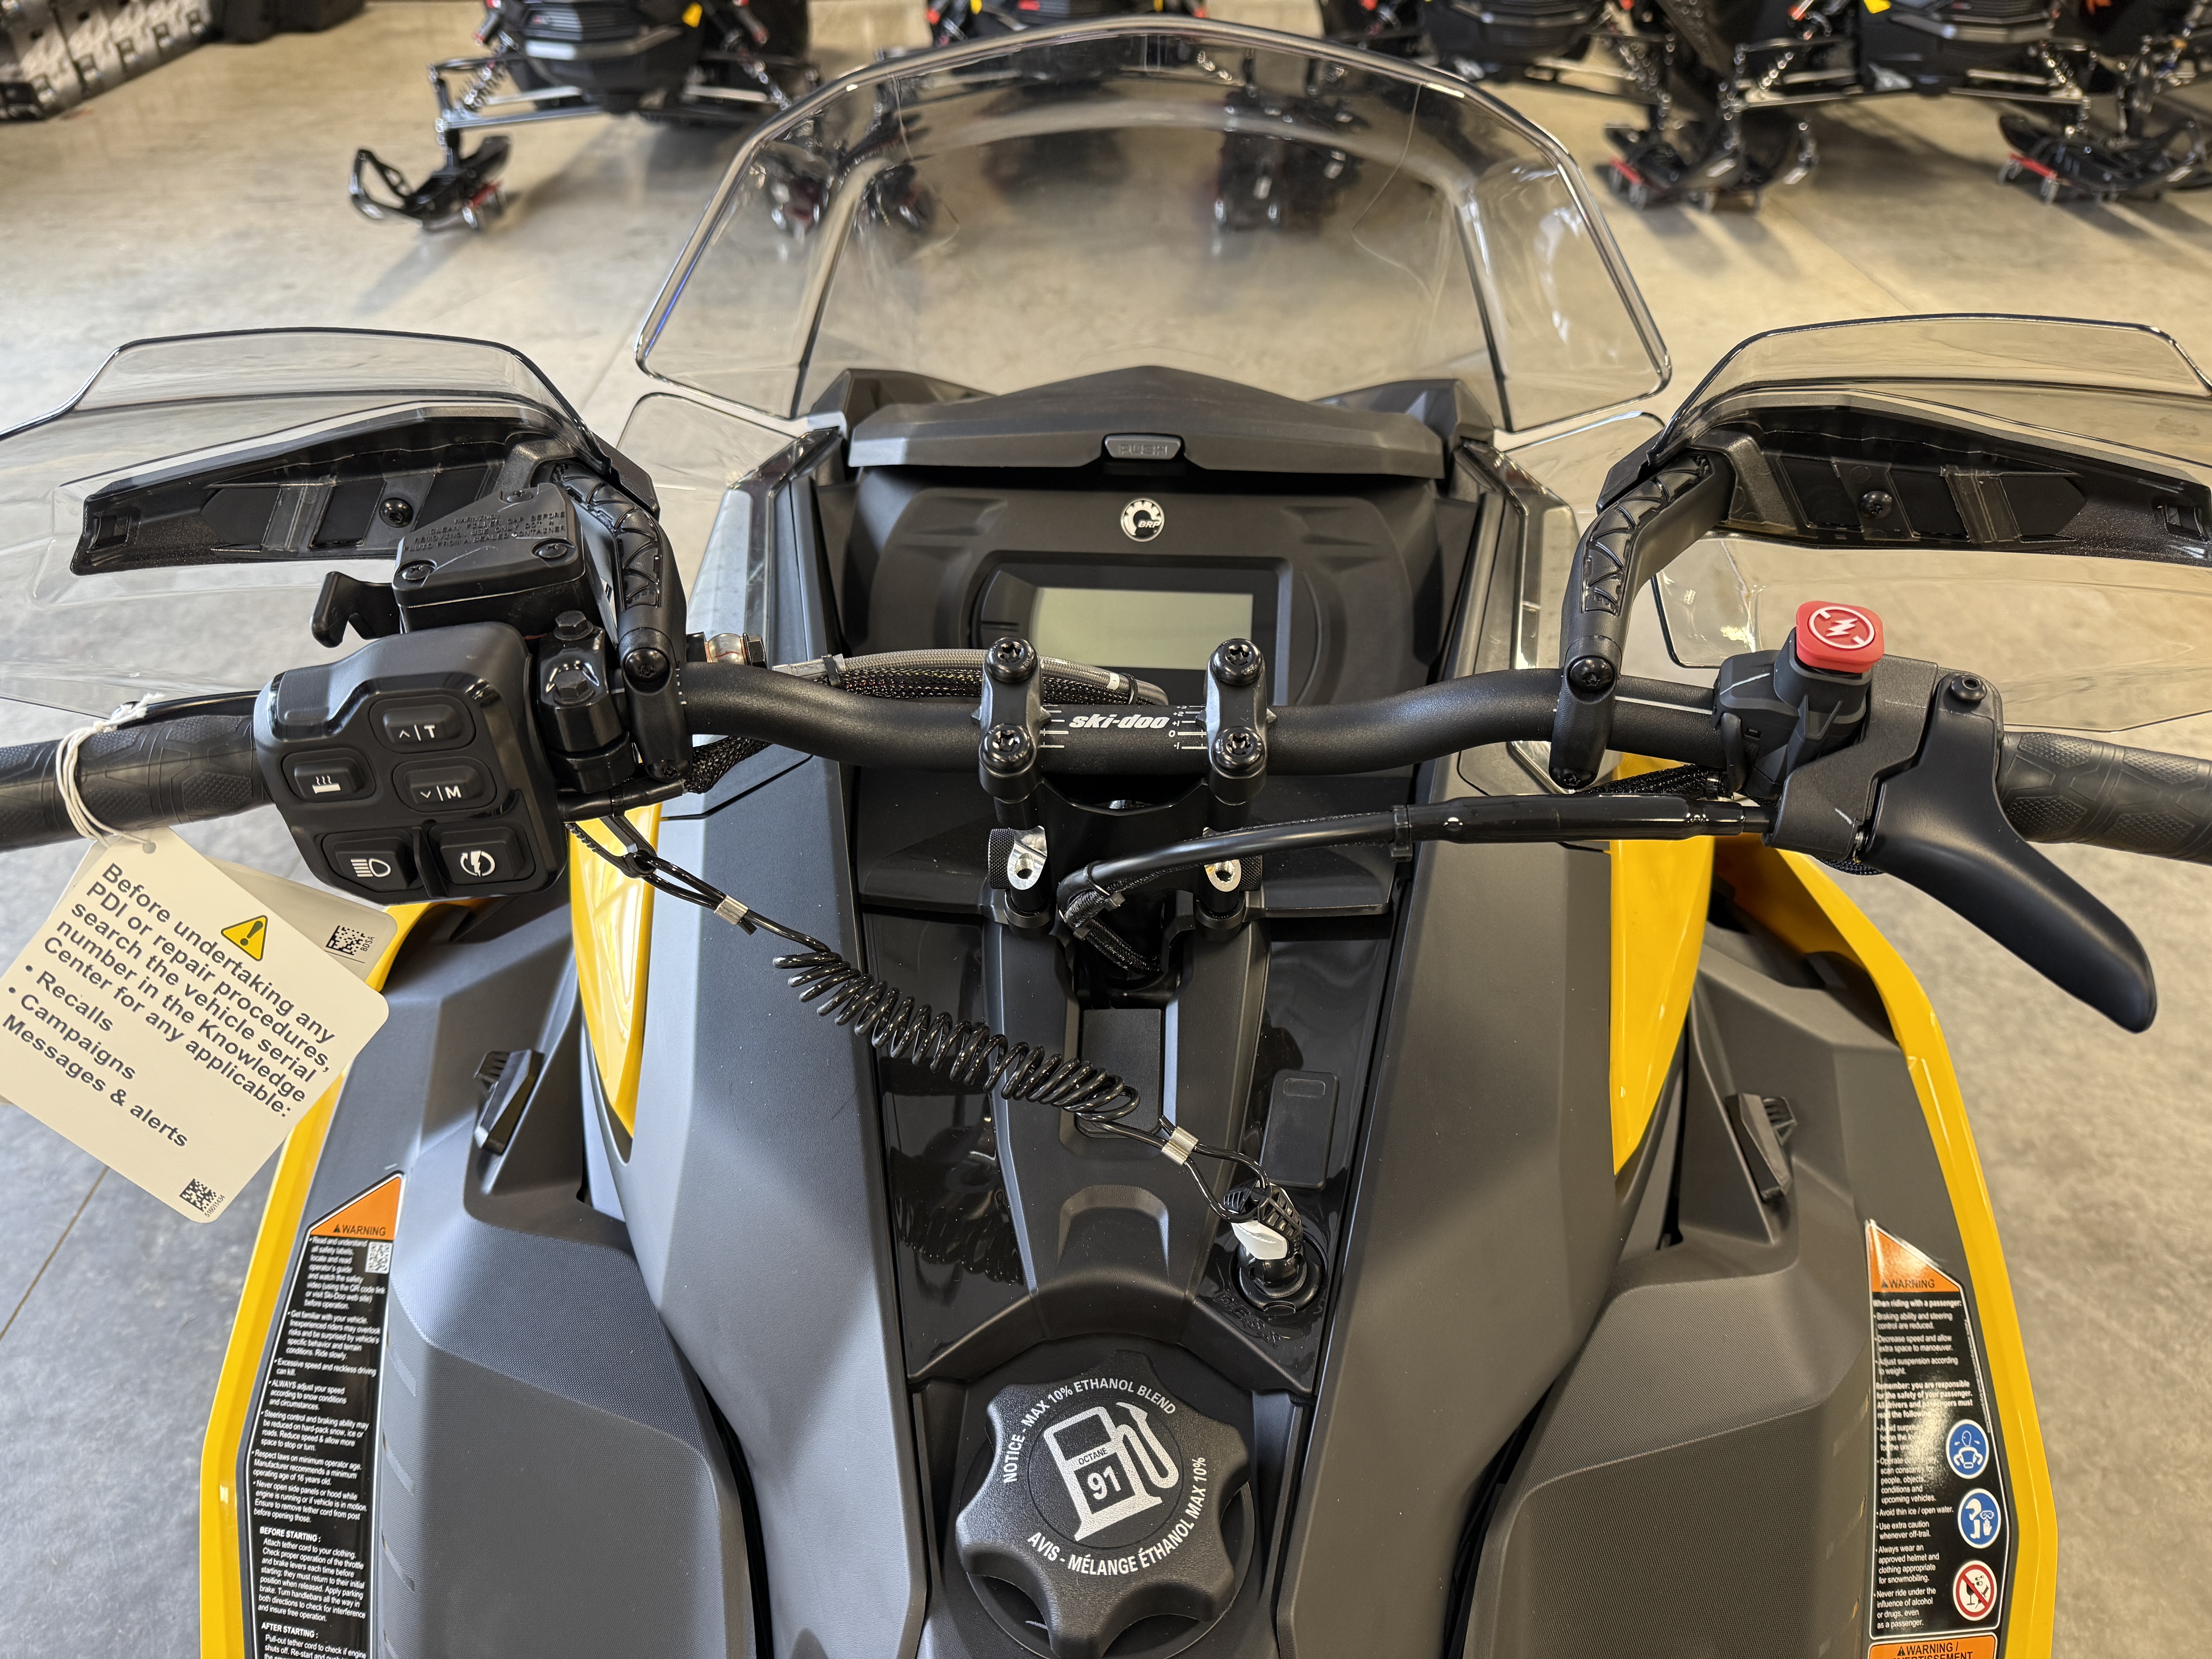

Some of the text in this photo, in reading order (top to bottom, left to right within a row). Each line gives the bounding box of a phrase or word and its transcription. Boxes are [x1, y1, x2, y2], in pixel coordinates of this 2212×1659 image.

[1120, 445, 1168, 456] PUSH
[1069, 714, 1170, 728] ski-doo
[424, 725, 435, 738] T
[445, 786, 461, 799] M
[360, 936, 375, 951] BDSA
[103, 863, 335, 1043] Before undertaking any
[87, 882, 329, 1073] PDI or repair procedures,
[37, 971, 112, 1030] Recalls
[72, 904, 317, 1082] search the vehicle serial
[57, 921, 305, 1101] number in the Knowledge
[45, 938, 290, 1117] Center for any applicable:
[21, 995, 135, 1079] Campaigns
[3, 1014, 187, 1146] Messages & alerts
[342, 1225, 386, 1236] WARNING
[1889, 1279, 1935, 1288] WARNING
[1003, 1434, 1025, 1483] NOTICE
[1021, 1400, 1050, 1427] MAX
[1048, 1386, 1073, 1403] 10%
[1073, 1378, 1134, 1393] ETHANOL
[1137, 1385, 1176, 1413] BLEND
[1079, 1448, 1108, 1465] OCTANE
[1192, 1457, 1207, 1481] 10%
[1088, 1466, 1121, 1501] 91
[1186, 1485, 1206, 1519] MAX
[1879, 1508, 1894, 1516] Avoid
[1921, 1507, 1936, 1515] open
[1908, 1520, 1929, 1528] caution
[259, 1526, 285, 1537] BEFORE
[286, 1530, 317, 1542] STARTING
[1909, 1529, 1930, 1538] off-trail.
[263, 1538, 280, 1547] Attach
[282, 1541, 298, 1549] tether
[332, 1549, 356, 1560] clothing.
[1027, 1532, 1060, 1561] AVIS
[1138, 1519, 1194, 1568] ÉTHANOL
[1878, 1546, 1899, 1554] Always
[263, 1547, 280, 1556] Check
[280, 1551, 299, 1559] proper
[299, 1554, 326, 1563] operation
[334, 1558, 343, 1566] the
[344, 1559, 364, 1570] throttle
[1068, 1554, 1138, 1575] MÉLANGE
[1879, 1554, 1905, 1565] approved
[1879, 1563, 1936, 1574] clothing appropriate
[1887, 1574, 1929, 1583] snowmobiling.
[259, 1585, 276, 1594] brake.
[278, 1587, 290, 1596] Turn
[291, 1590, 322, 1601] handlebars
[331, 1596, 340, 1604] the
[342, 1599, 354, 1608] way
[1908, 1587, 1925, 1595] under
[259, 1594, 271, 1602] both
[272, 1596, 298, 1607] directions
[306, 1602, 322, 1611] check
[332, 1606, 365, 1618] interference
[1911, 1597, 1932, 1606] alcohol
[269, 1605, 286, 1614] insure
[287, 1608, 298, 1617] free
[299, 1612, 326, 1621] operation.
[1884, 1610, 1903, 1619] drugs,
[261, 1622, 282, 1632] AFTER
[283, 1625, 314, 1638] STARTING
[1891, 1620, 1923, 1629] passenger.
[265, 1634, 286, 1645] Pull-out
[287, 1638, 304, 1647] tether
[325, 1645, 342, 1654] check
[348, 1650, 366, 1659] engine
[1907, 1643, 1953, 1655] WARNING
